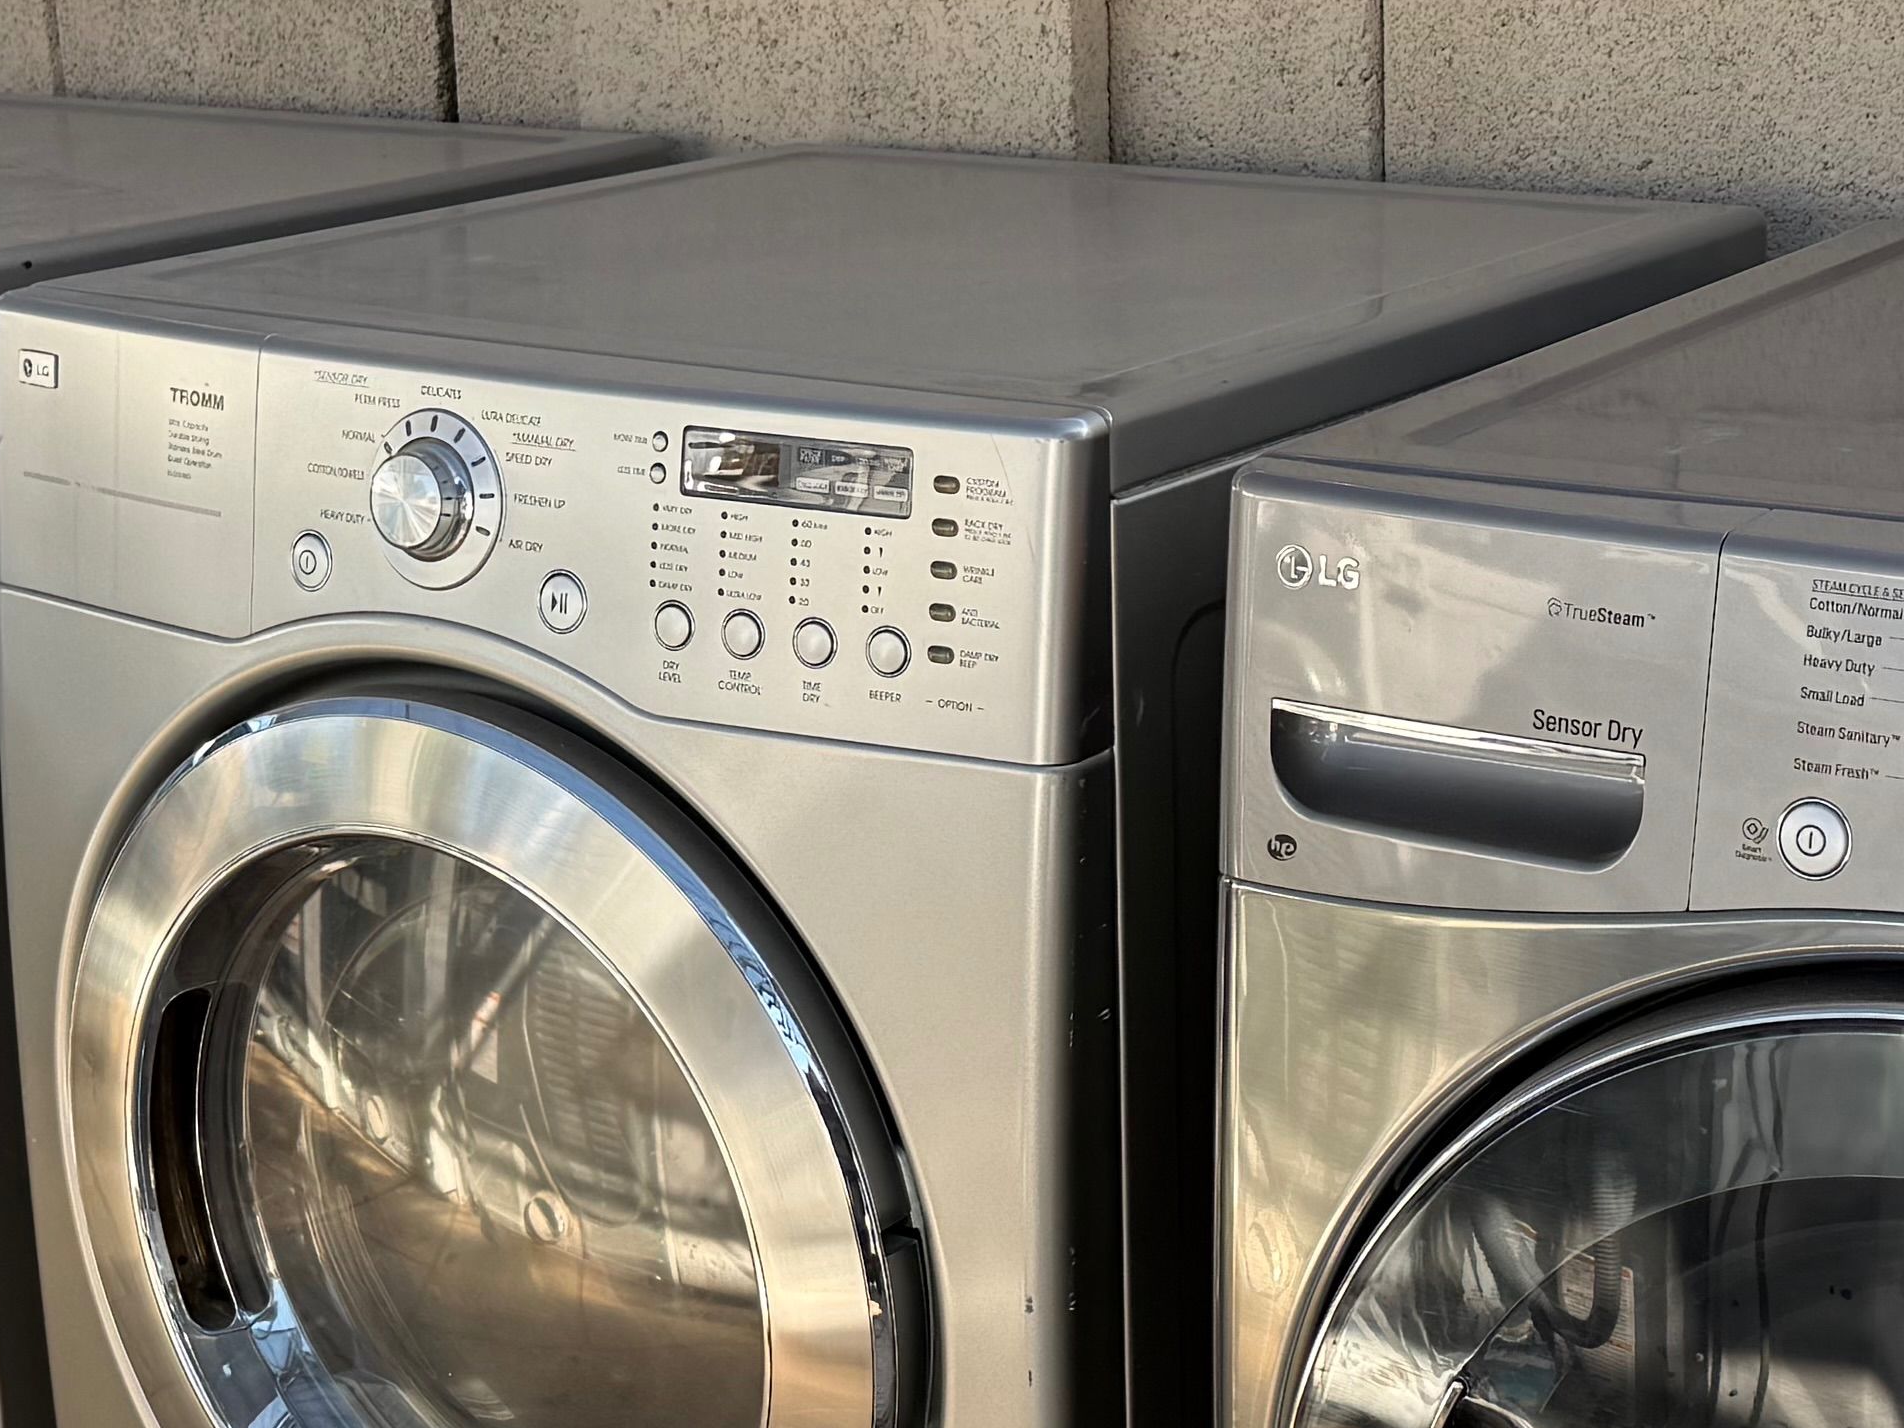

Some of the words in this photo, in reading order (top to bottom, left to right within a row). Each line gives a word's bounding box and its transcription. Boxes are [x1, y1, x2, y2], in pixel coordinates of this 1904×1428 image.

[37, 364, 49, 377] LG
[169, 387, 225, 411] TROMM
[342, 429, 376, 444] NORMAL
[525, 541, 543, 552] DRY
[1318, 555, 1360, 590] LG
[1812, 579, 1847, 592] STEAM
[1849, 583, 1879, 597] CYCLE
[1882, 587, 1890, 598] &
[1809, 597, 1904, 620] Cotton/Normal
[1806, 624, 1882, 648] Bulky/Large
[662, 659, 680, 671] DRY
[1803, 654, 1842, 672] Heavy
[1845, 659, 1875, 677] Duty
[658, 671, 682, 683] LEVEL
[717, 680, 761, 695] CONTROL
[802, 680, 822, 692] TIME
[802, 692, 820, 703] DRY
[869, 689, 902, 703] BEEPER
[1800, 686, 1833, 703] Small
[1835, 691, 1865, 707] Load
[937, 698, 972, 712] OPTION
[1531, 708, 1602, 739] Sensor
[1607, 719, 1644, 750] Dry
[1797, 720, 1835, 738] Steam
[1793, 757, 1832, 775] Steam
